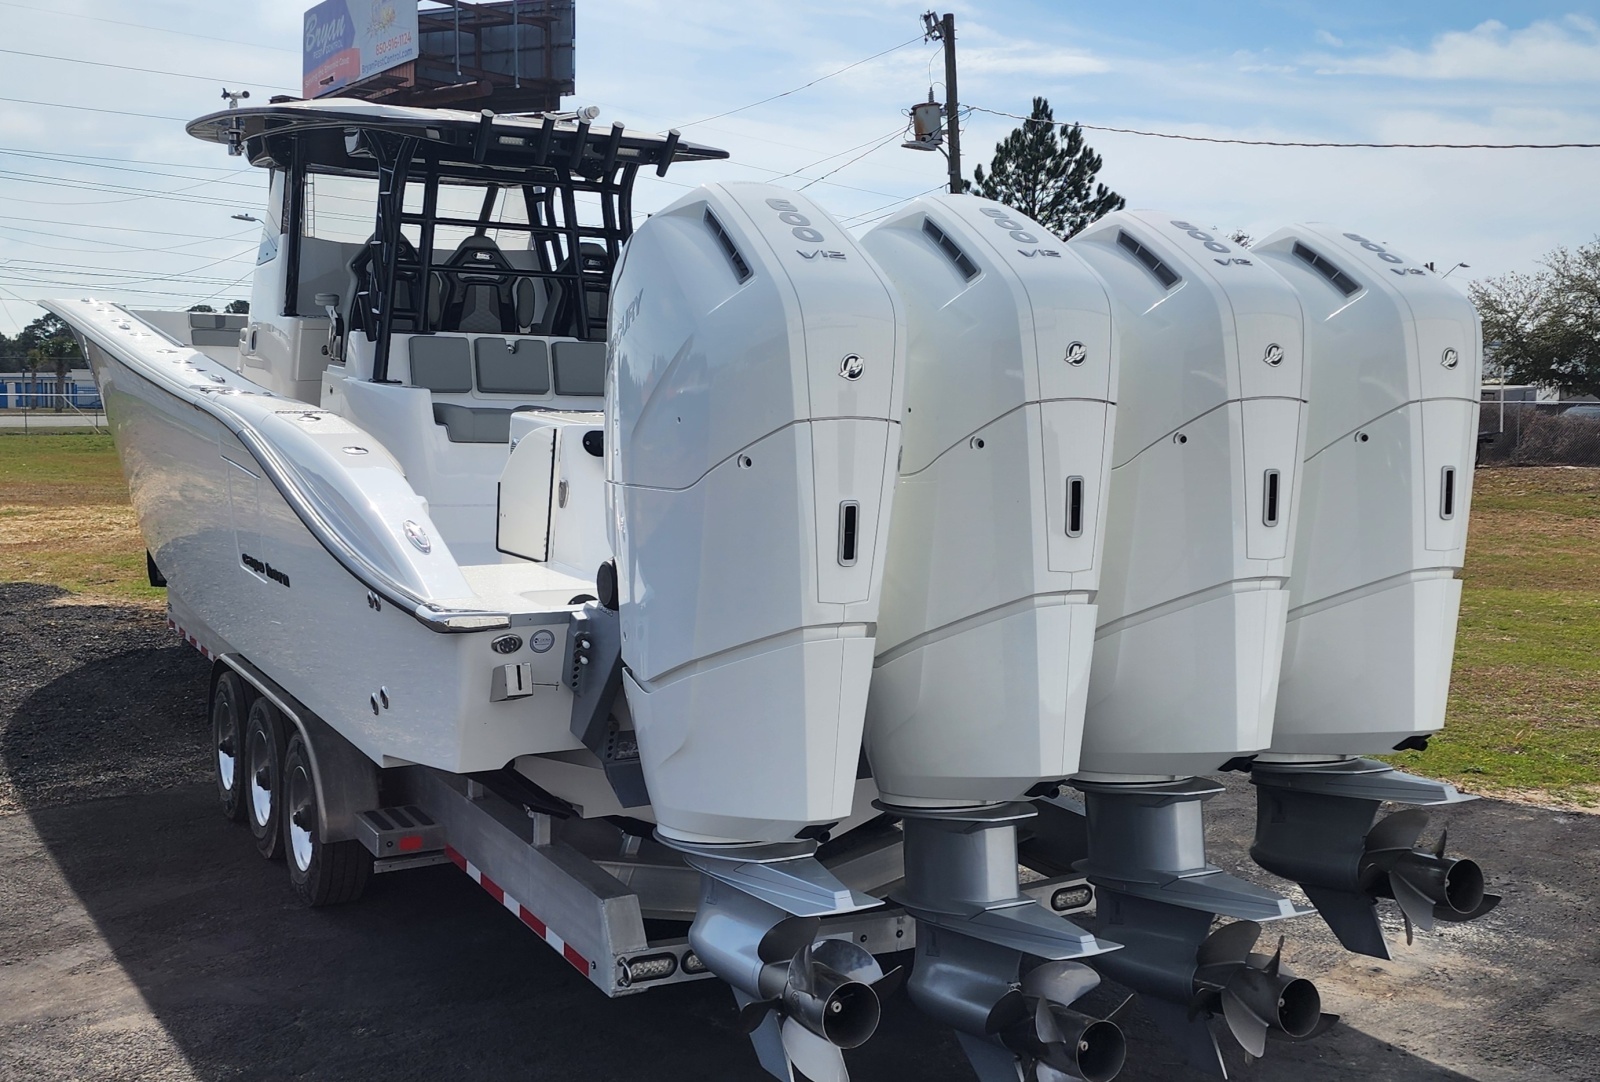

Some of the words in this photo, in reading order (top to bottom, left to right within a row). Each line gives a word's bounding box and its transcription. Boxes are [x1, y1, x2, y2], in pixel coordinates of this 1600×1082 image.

[305, 13, 346, 55] Bryan
[375, 31, 412, 56] 850-916-1124
[361, 48, 413, 74] BryanPestControl.com
[765, 198, 825, 243] 500
[979, 207, 1039, 244] 500
[1170, 220, 1231, 254] 500
[1342, 233, 1404, 264] 500
[796, 249, 847, 261] V12
[1017, 249, 1062, 259] V12
[1213, 258, 1254, 267] V12
